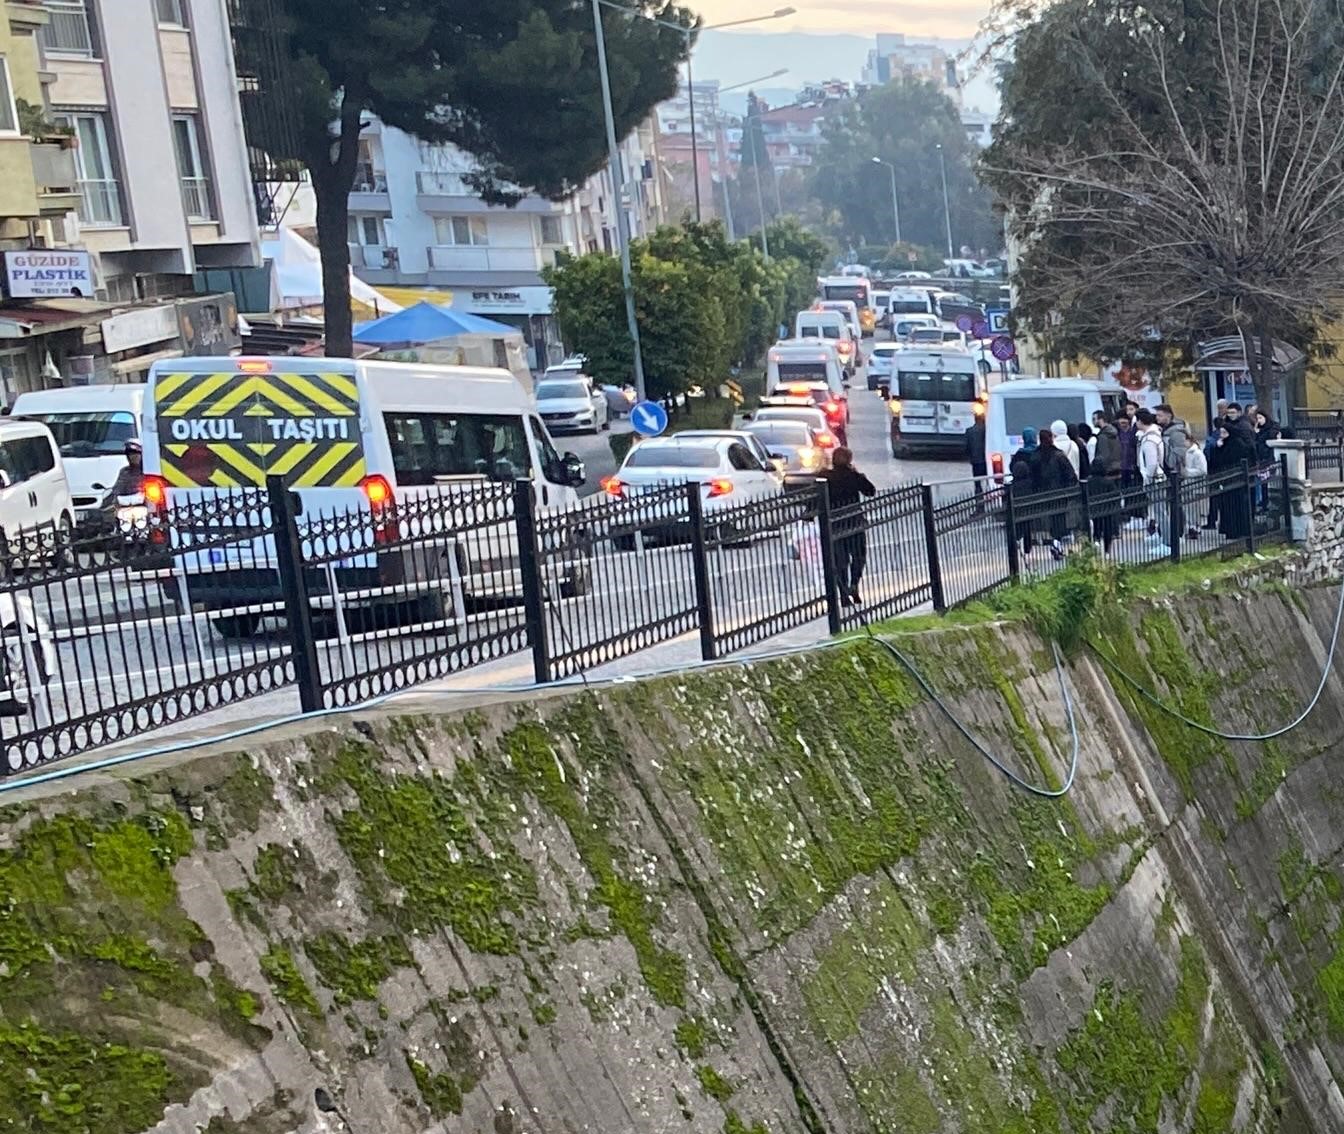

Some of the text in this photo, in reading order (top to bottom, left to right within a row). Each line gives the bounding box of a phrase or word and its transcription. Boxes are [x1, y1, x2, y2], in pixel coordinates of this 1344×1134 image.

[14, 254, 80, 267] GÜZİDE
[12, 269, 87, 281] PLASTİK
[171, 418, 348, 444] OKUL TAŞITI
